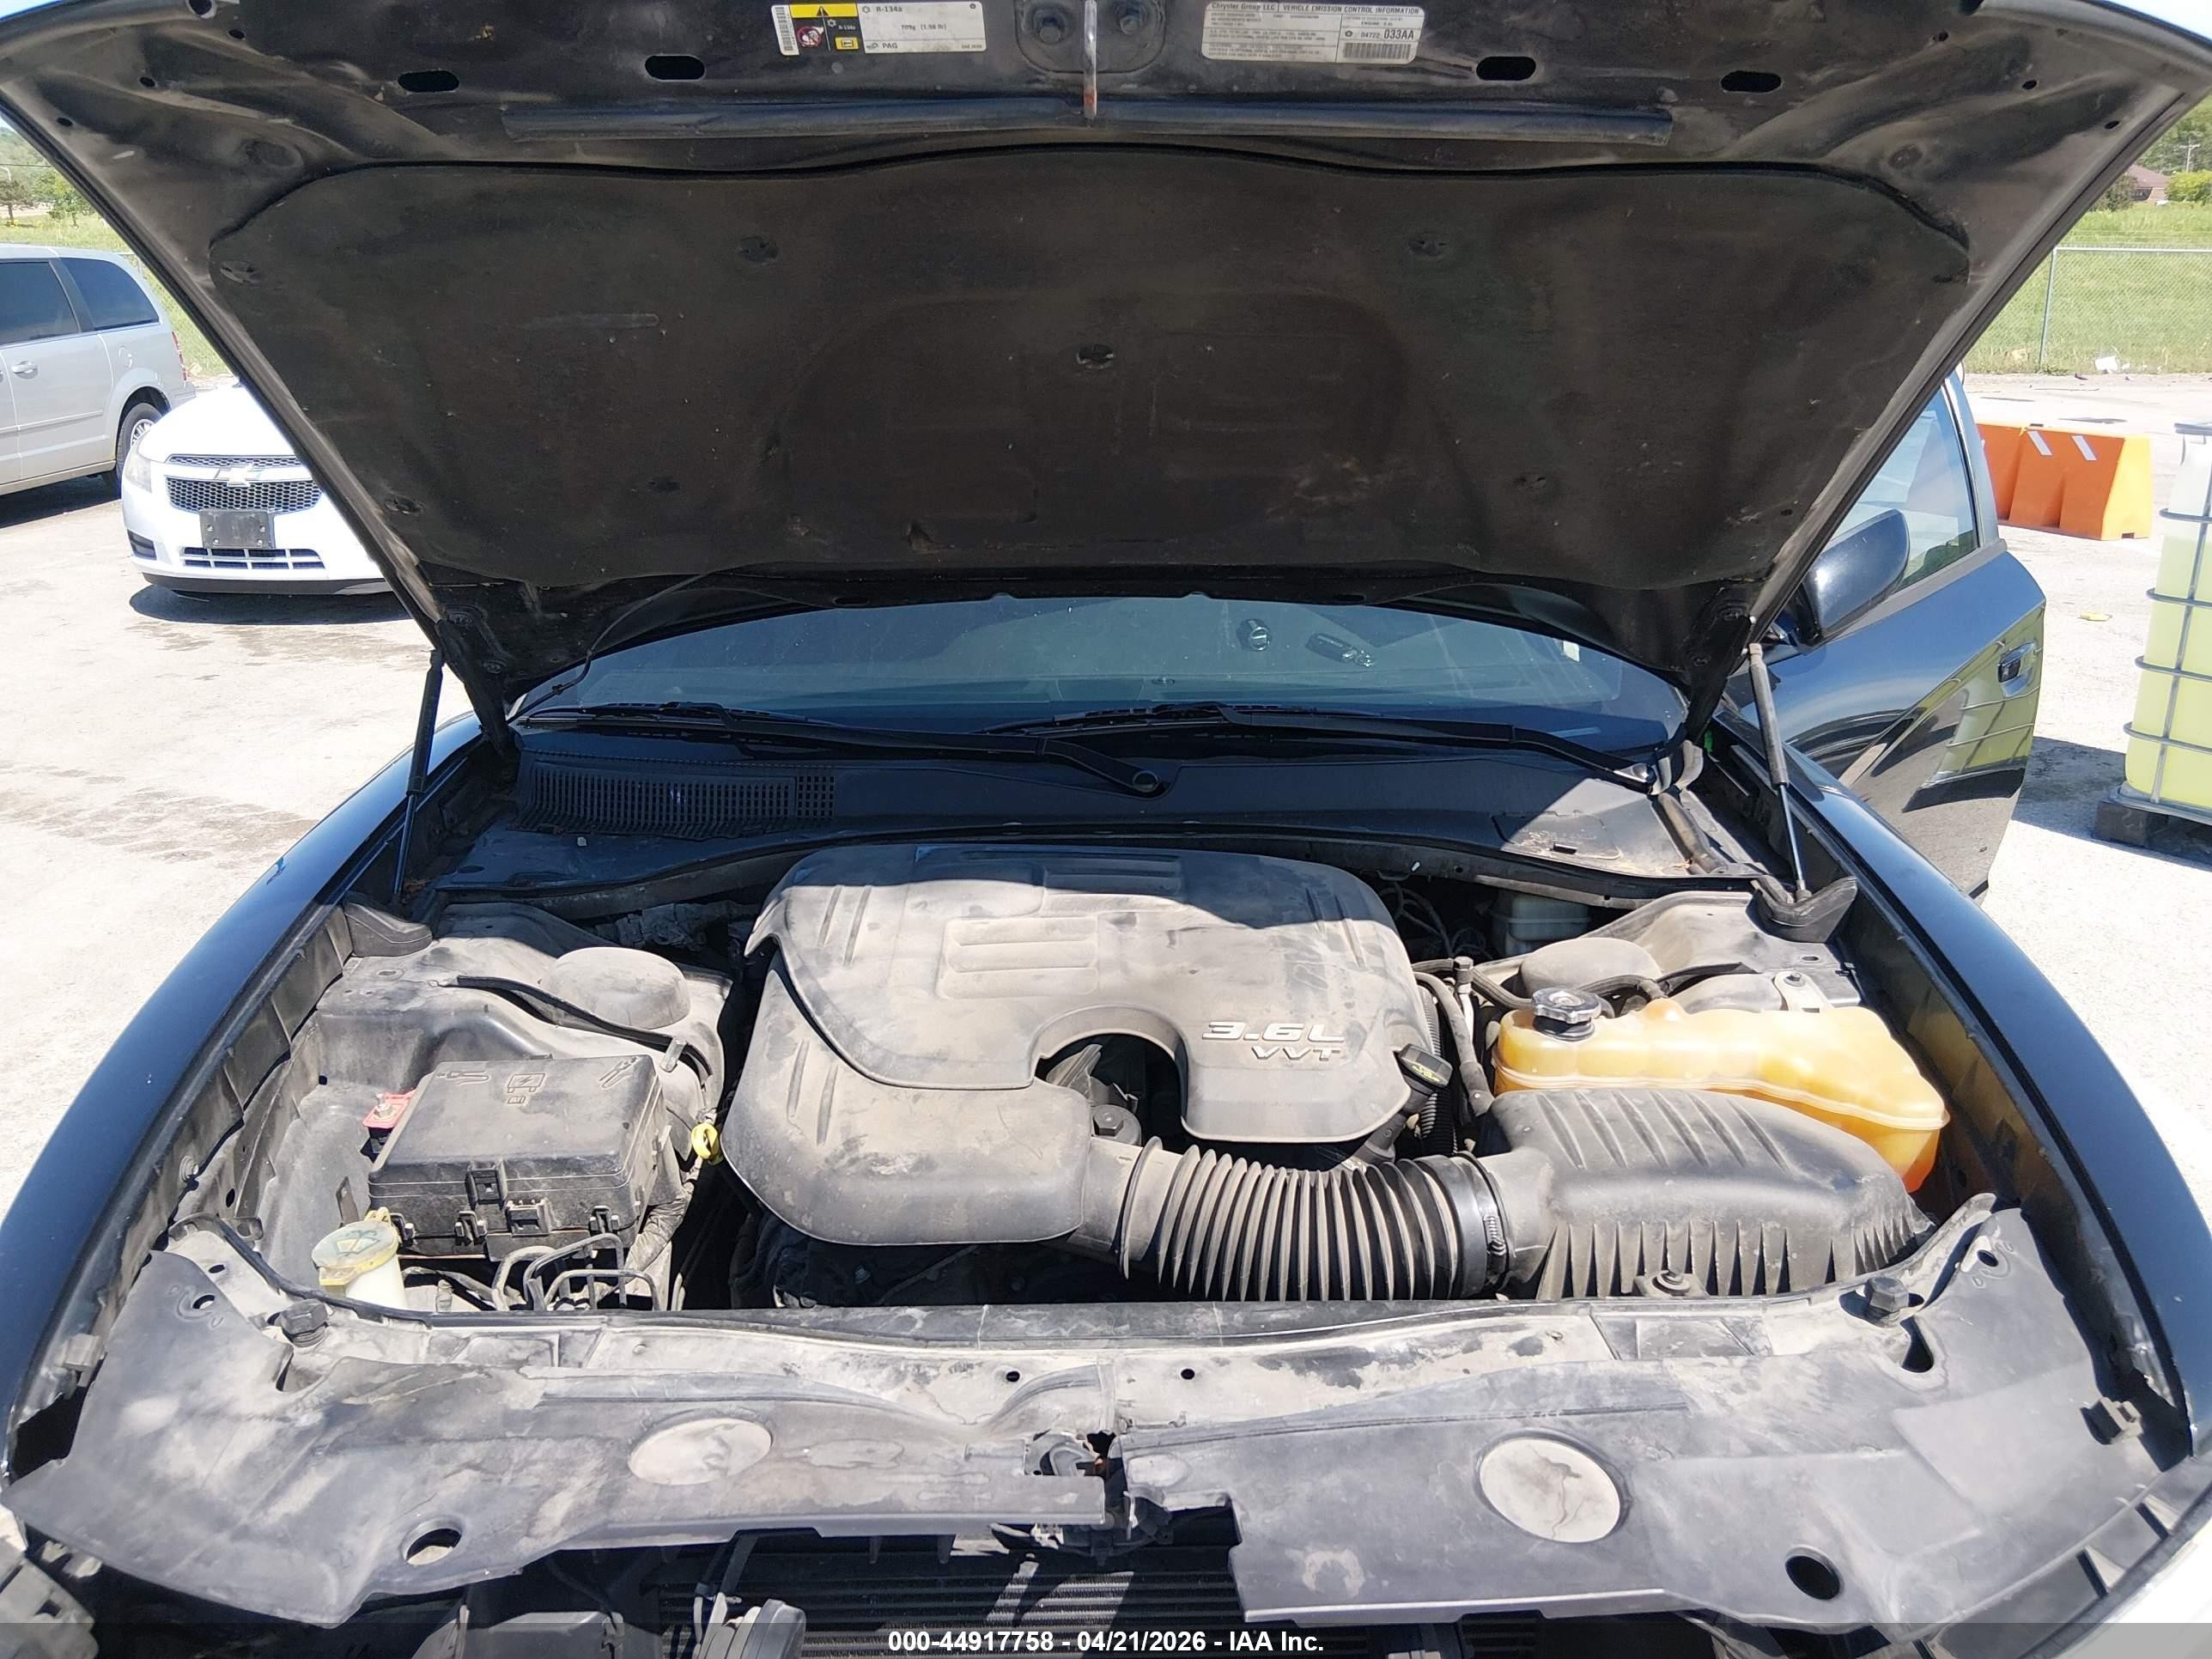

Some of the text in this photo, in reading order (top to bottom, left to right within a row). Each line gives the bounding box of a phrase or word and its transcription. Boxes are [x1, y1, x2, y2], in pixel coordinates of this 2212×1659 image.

[1211, 2, 1239, 10] Chrysler
[1241, 3, 1261, 11] Group
[1283, 4, 1310, 13] VEHICLE
[1310, 5, 1342, 14] EMISSION
[1383, 28, 1415, 40] 033AA
[1202, 1021, 1346, 1043] 3.6L
[1251, 1046, 1341, 1061] VVT
